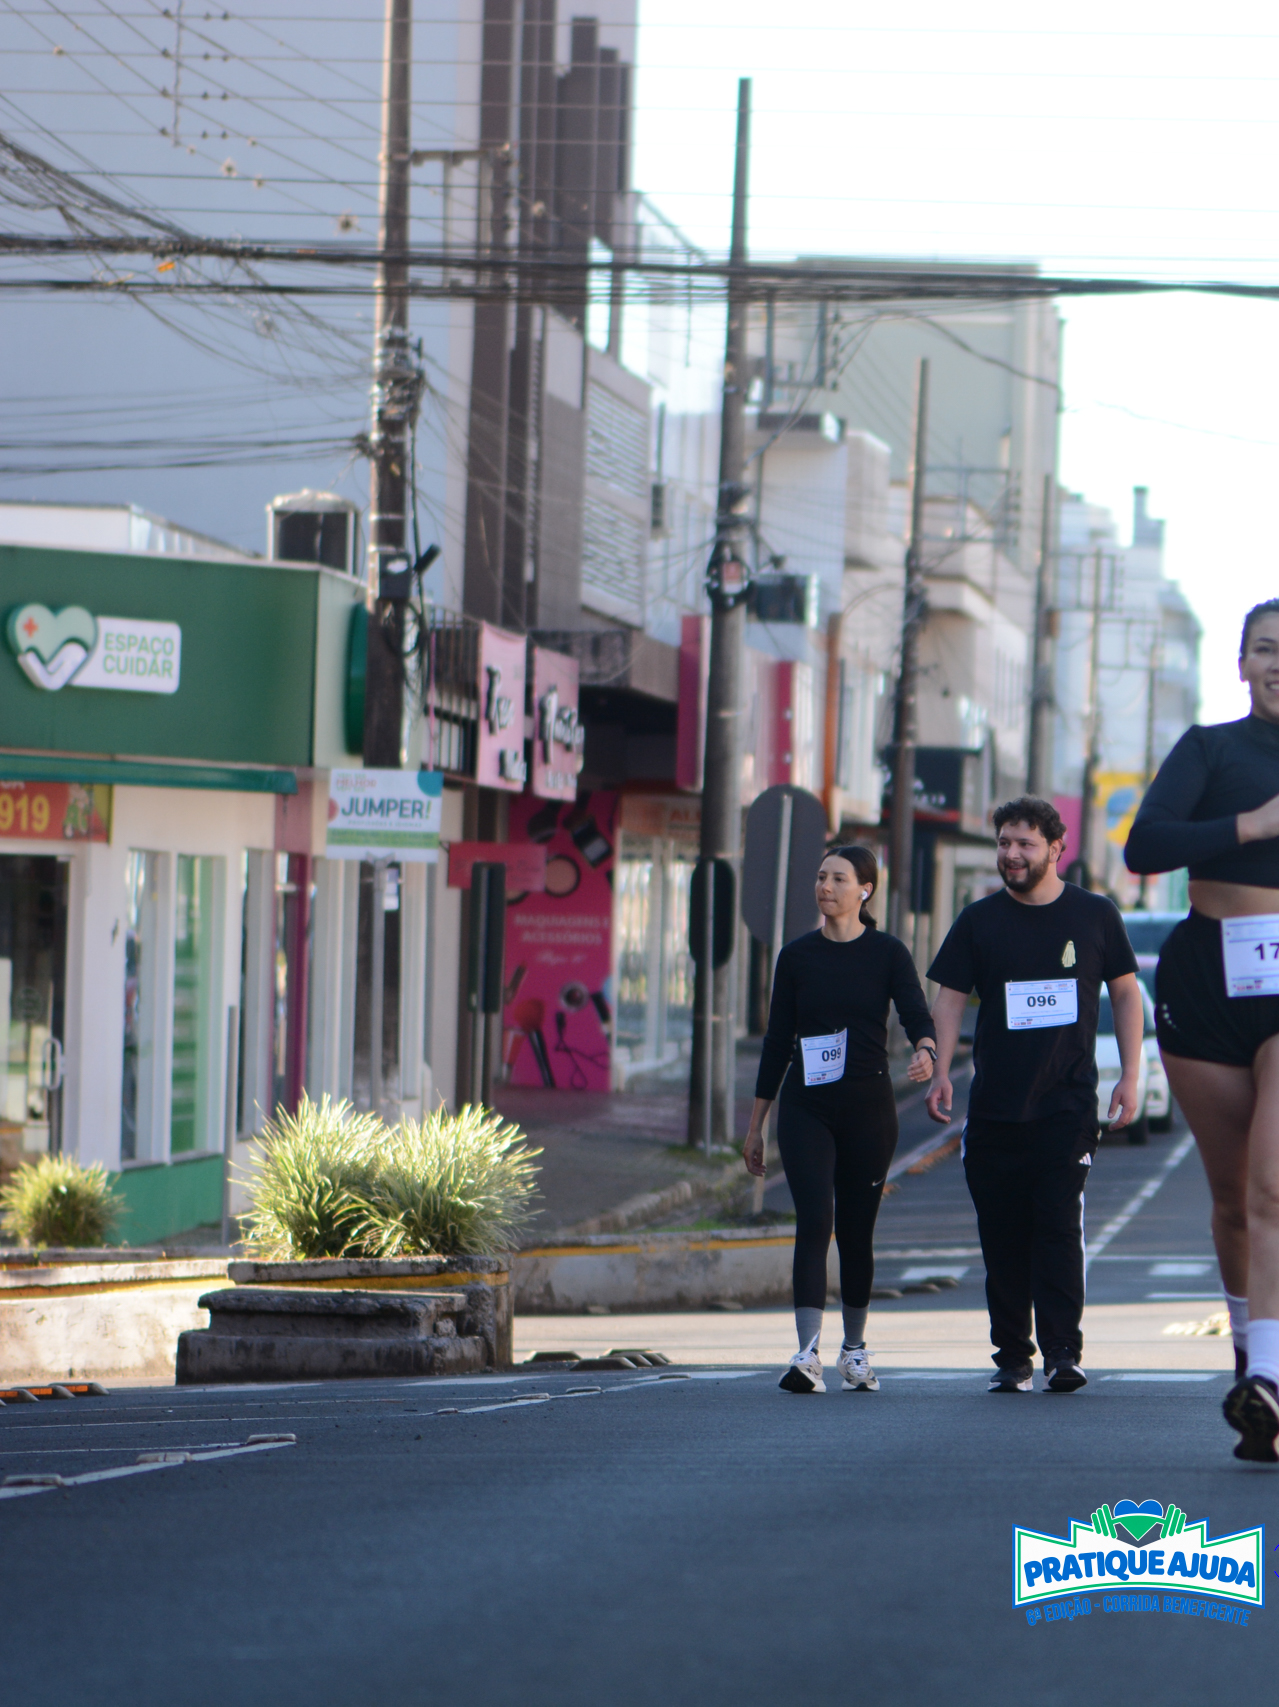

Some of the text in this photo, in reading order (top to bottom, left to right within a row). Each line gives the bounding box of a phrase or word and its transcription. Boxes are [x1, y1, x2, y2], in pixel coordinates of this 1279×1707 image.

[104, 632, 175, 657] ESPAÇO
[103, 653, 174, 678] CUIDAR
[341, 797, 432, 820] JUMPER!
[1027, 994, 1057, 1007] 096
[821, 1047, 842, 1062] 099
